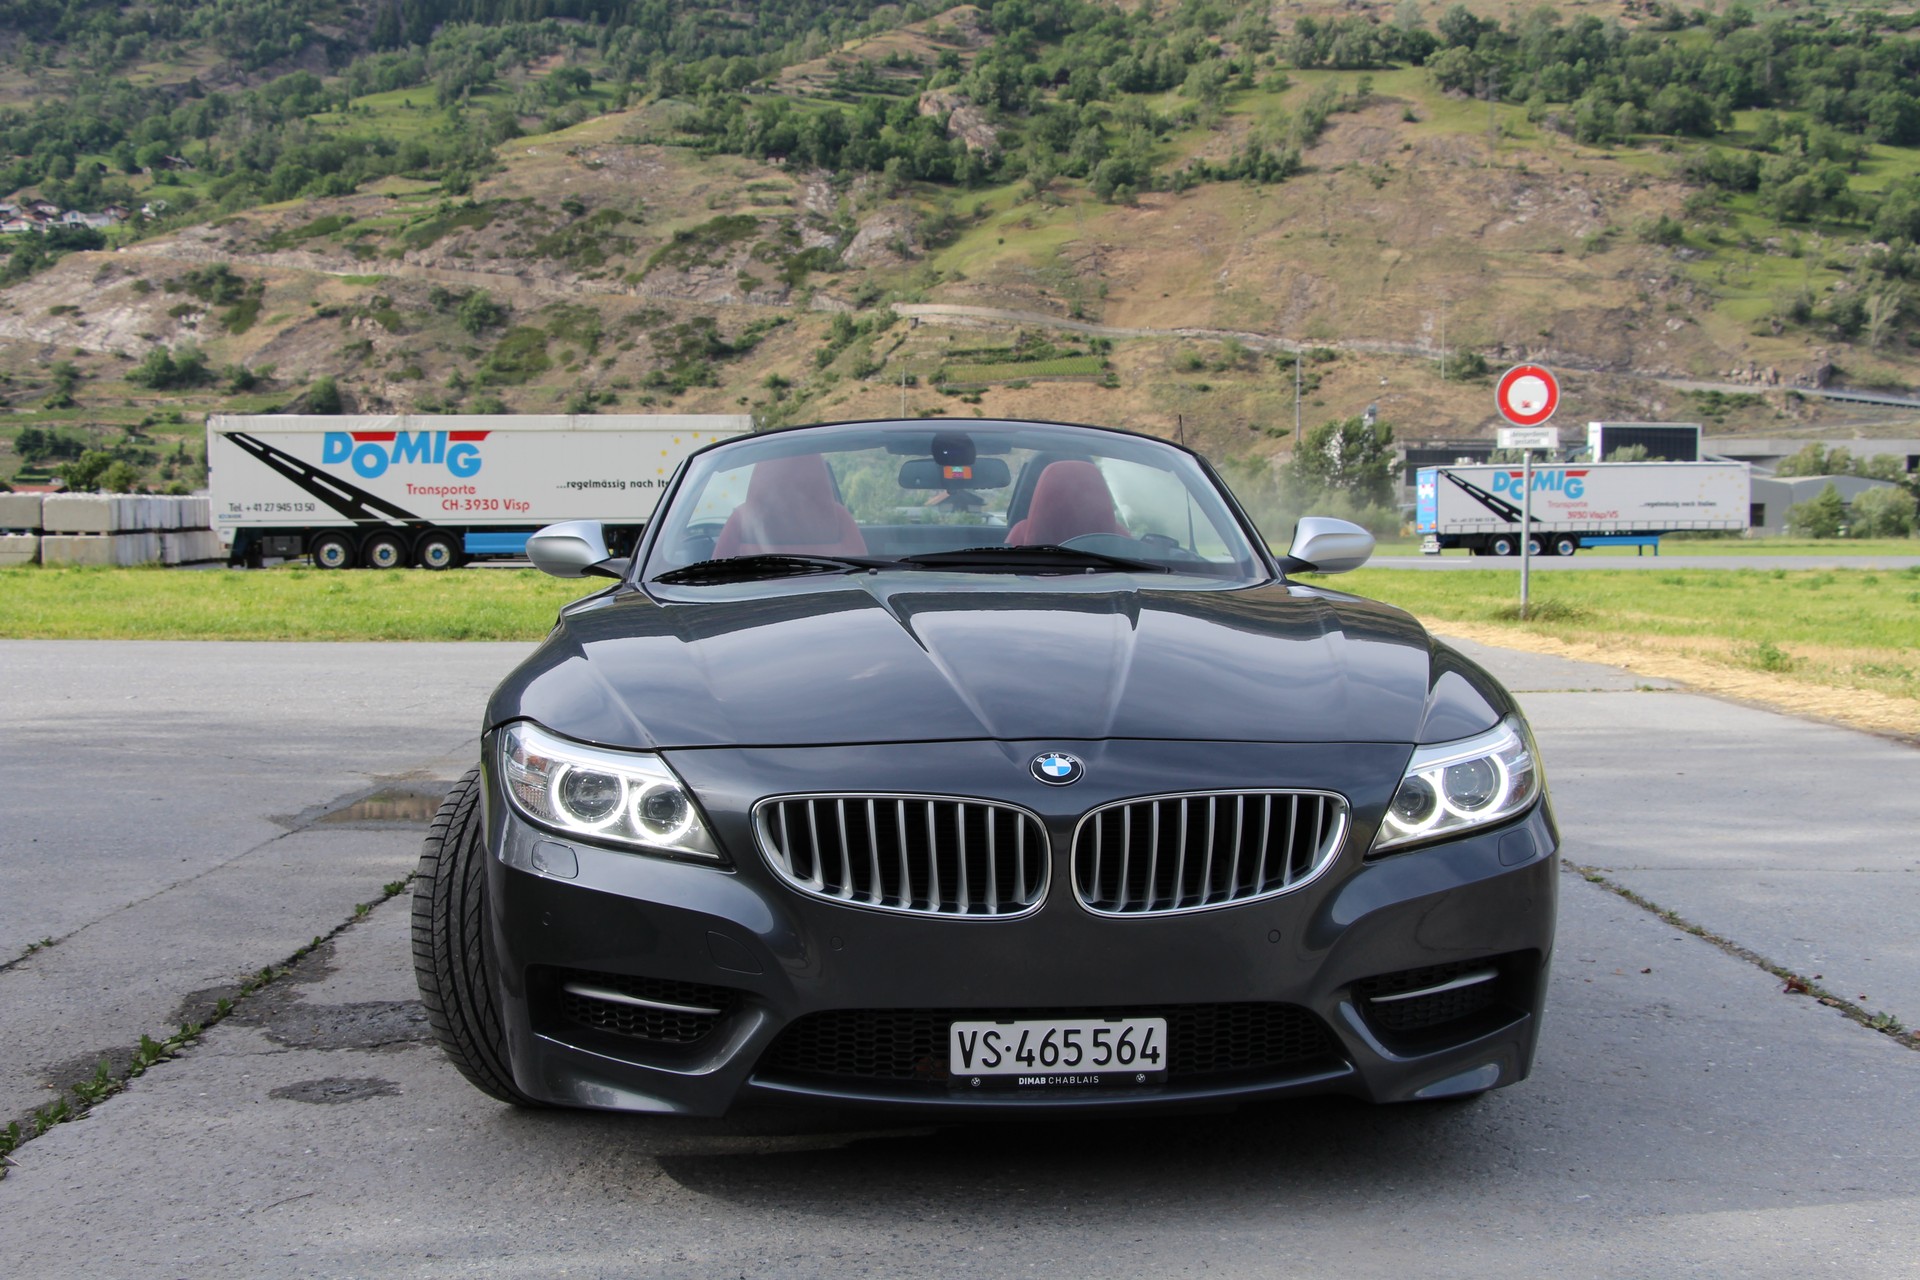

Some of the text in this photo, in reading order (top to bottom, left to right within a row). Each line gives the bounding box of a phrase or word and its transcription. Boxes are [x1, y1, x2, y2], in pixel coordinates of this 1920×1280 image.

[322, 431, 483, 479] DOMIG
[630, 480, 653, 489] nach
[406, 483, 476, 497] Transporte
[265, 503, 274, 512] 27
[276, 503, 292, 512] 945
[294, 503, 303, 512] 13
[304, 503, 315, 512] 50
[441, 499, 530, 513] CH-3930 Visp
[1036, 754, 1075, 763] BMW
[1018, 1075, 1099, 1085] DIMAB CHABLAIS
